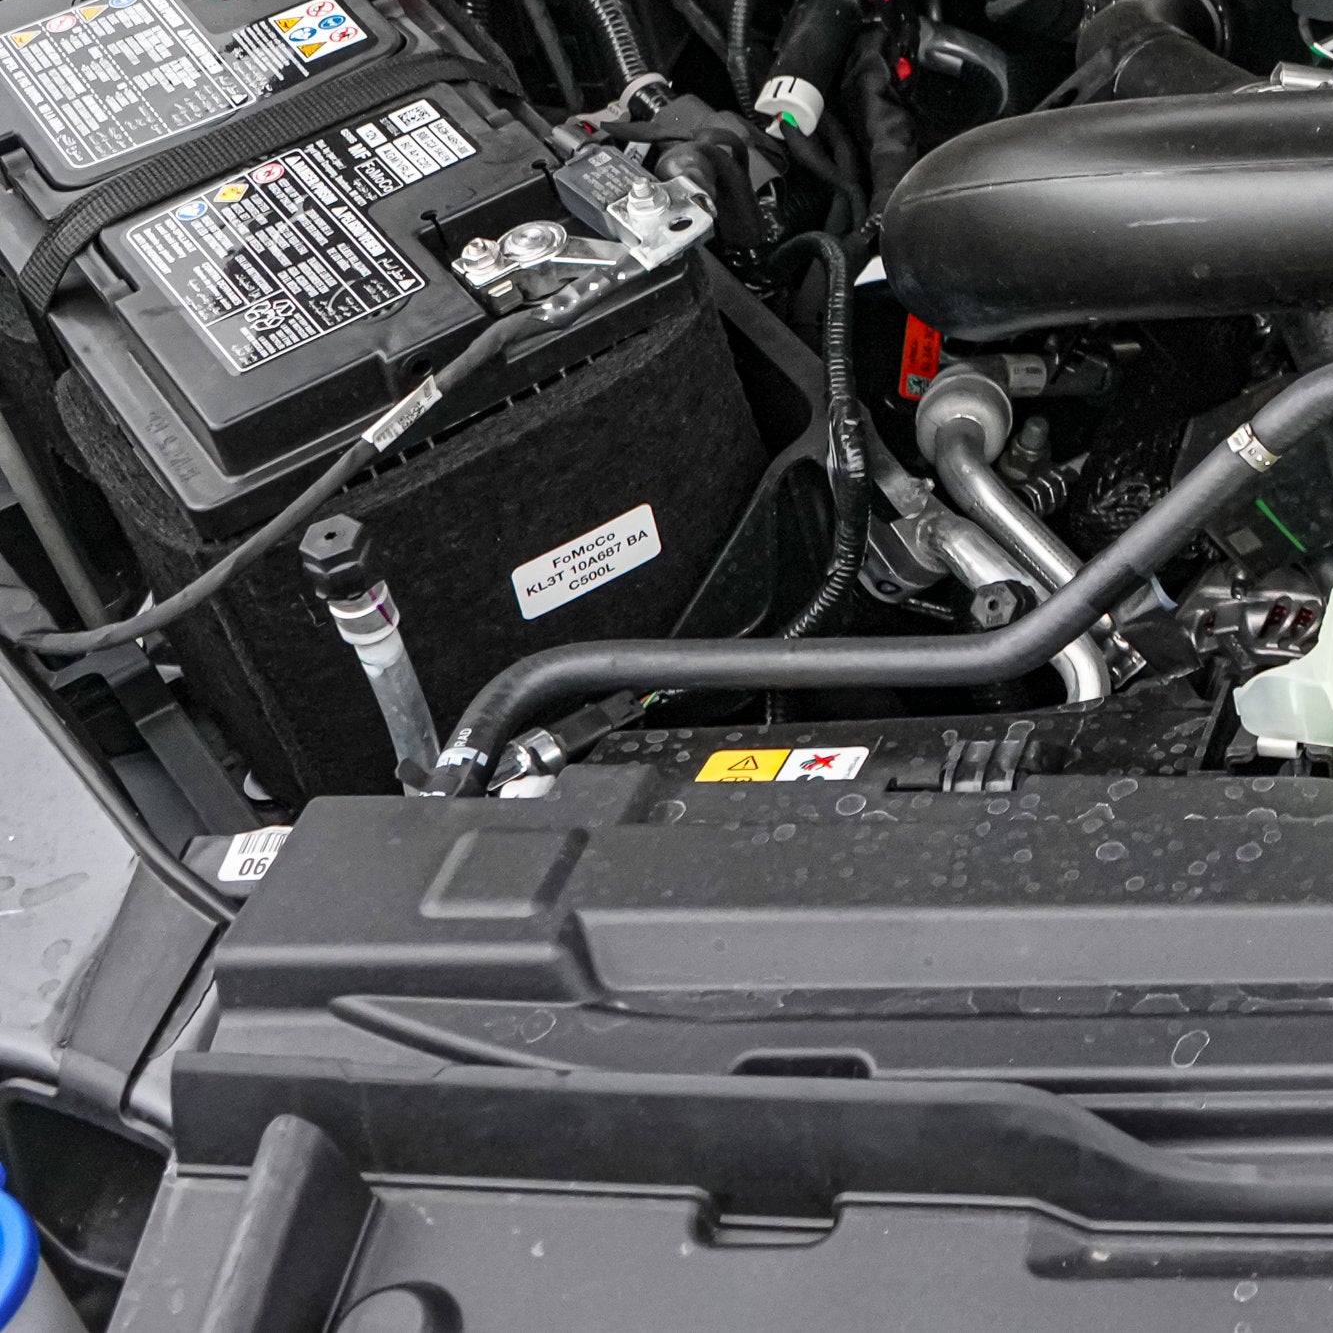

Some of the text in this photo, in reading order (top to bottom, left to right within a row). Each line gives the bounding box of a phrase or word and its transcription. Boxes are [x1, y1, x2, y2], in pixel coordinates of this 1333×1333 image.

[361, 161, 394, 193] FoMoCo
[526, 529, 649, 597] KL3T 10A687 BA
[552, 531, 616, 568] FoMoCo
[569, 562, 616, 591] C500L
[454, 727, 472, 747] RAD
[238, 856, 267, 876] 06
